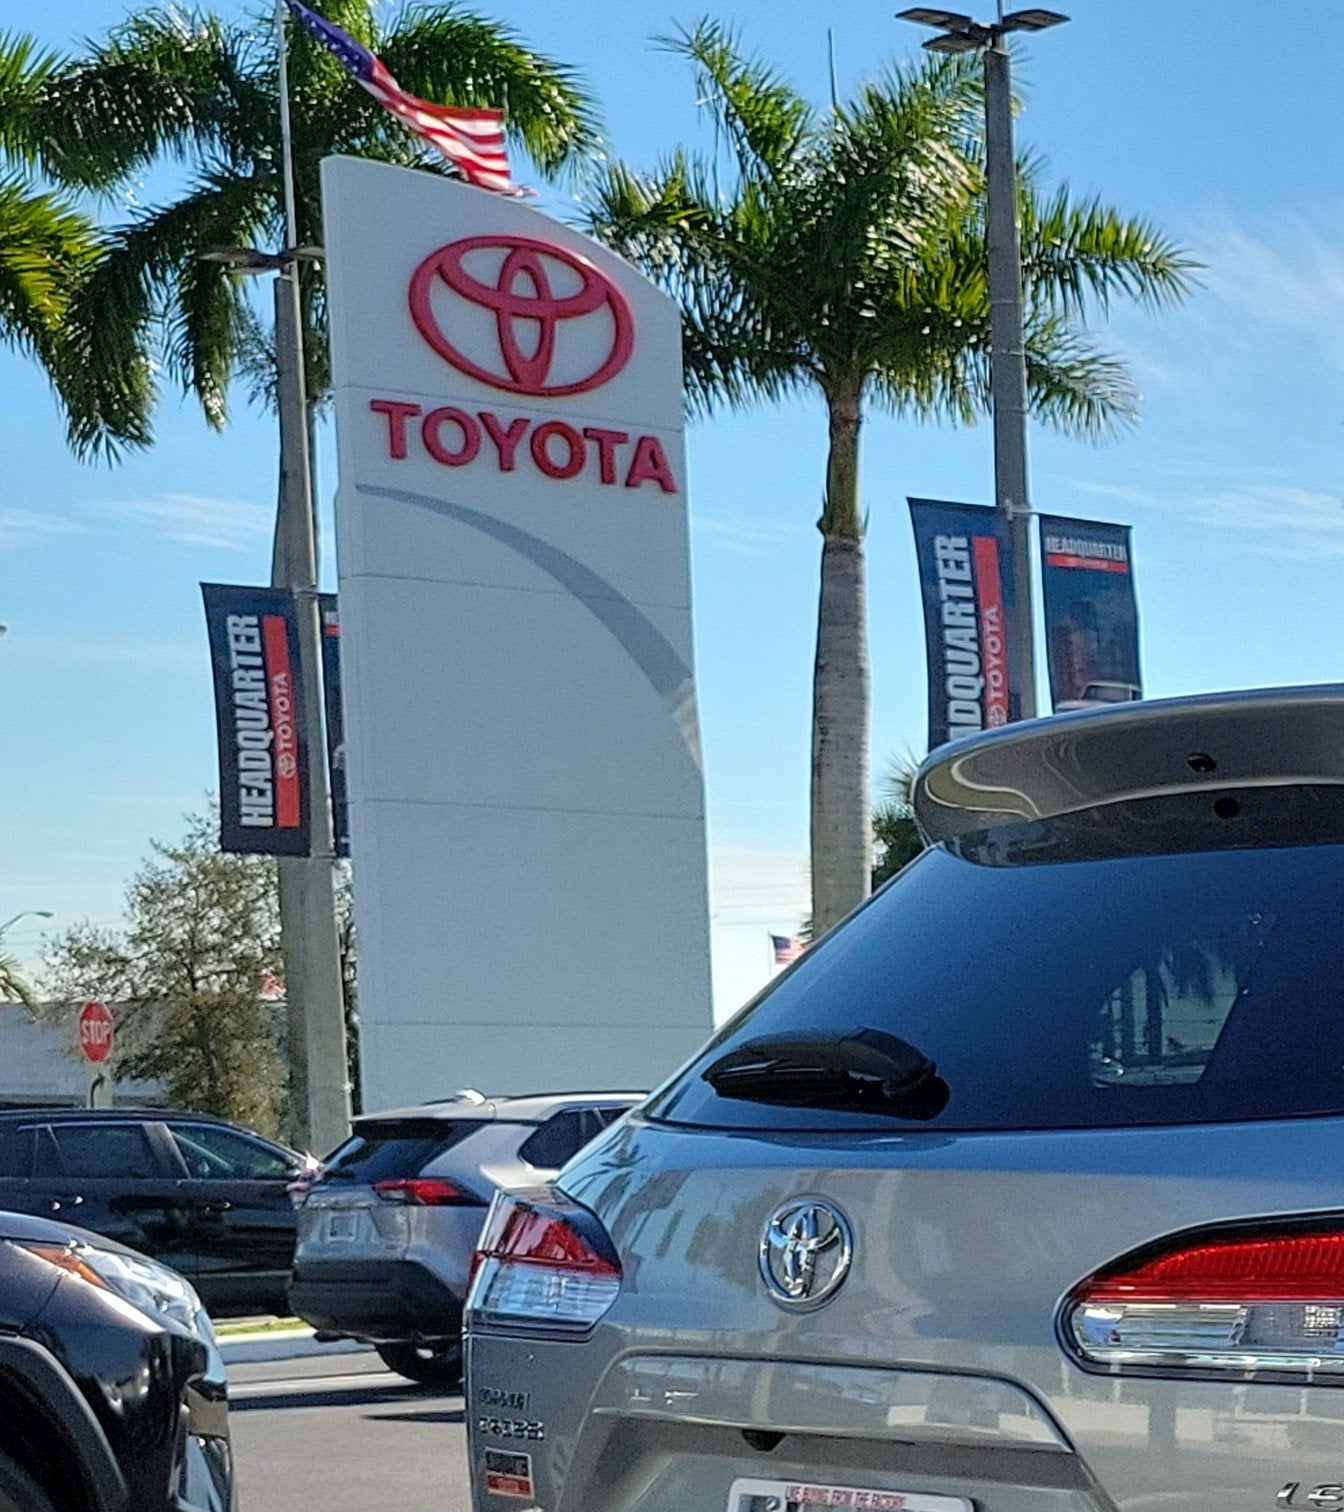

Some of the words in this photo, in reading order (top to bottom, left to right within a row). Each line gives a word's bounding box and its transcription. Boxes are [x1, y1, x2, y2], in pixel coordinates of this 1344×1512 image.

[370, 399, 678, 493] TOYOTA
[983, 607, 1005, 700] TOYOTA
[226, 614, 274, 828] HEADQUARTER
[272, 672, 294, 750] TOYOTA
[81, 1020, 110, 1044] STOP
